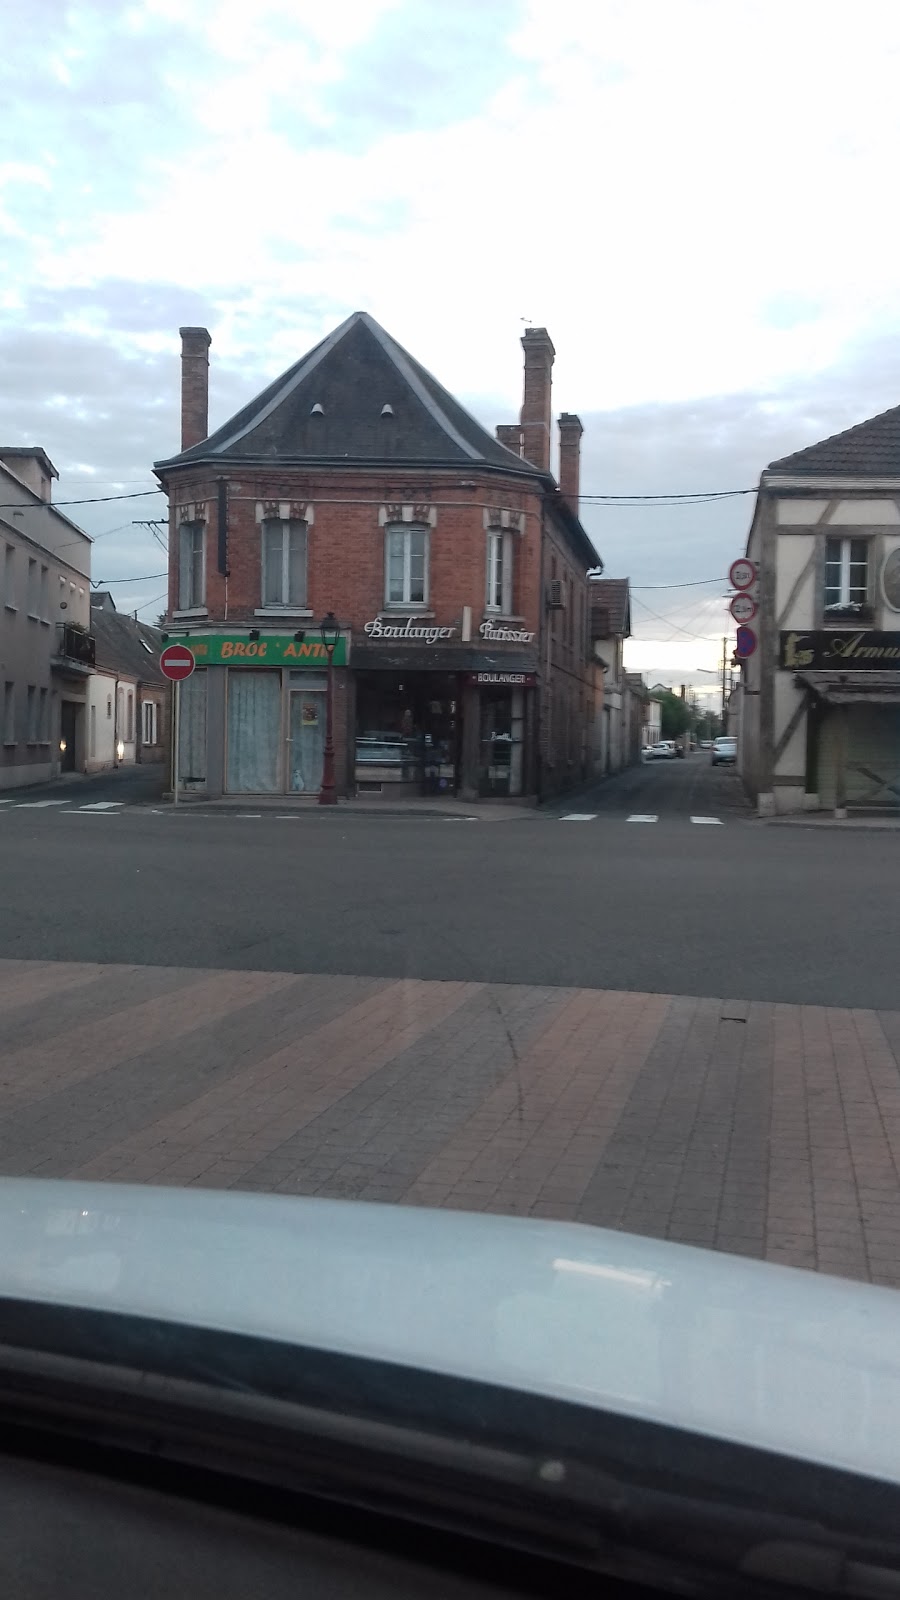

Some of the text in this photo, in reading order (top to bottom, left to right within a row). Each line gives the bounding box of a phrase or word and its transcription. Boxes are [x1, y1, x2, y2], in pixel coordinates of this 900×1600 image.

[364, 616, 457, 645] Boulanger
[220, 641, 268, 659] BROC
[822, 632, 900, 658] Armu
[477, 672, 526, 684] BOULANGER
